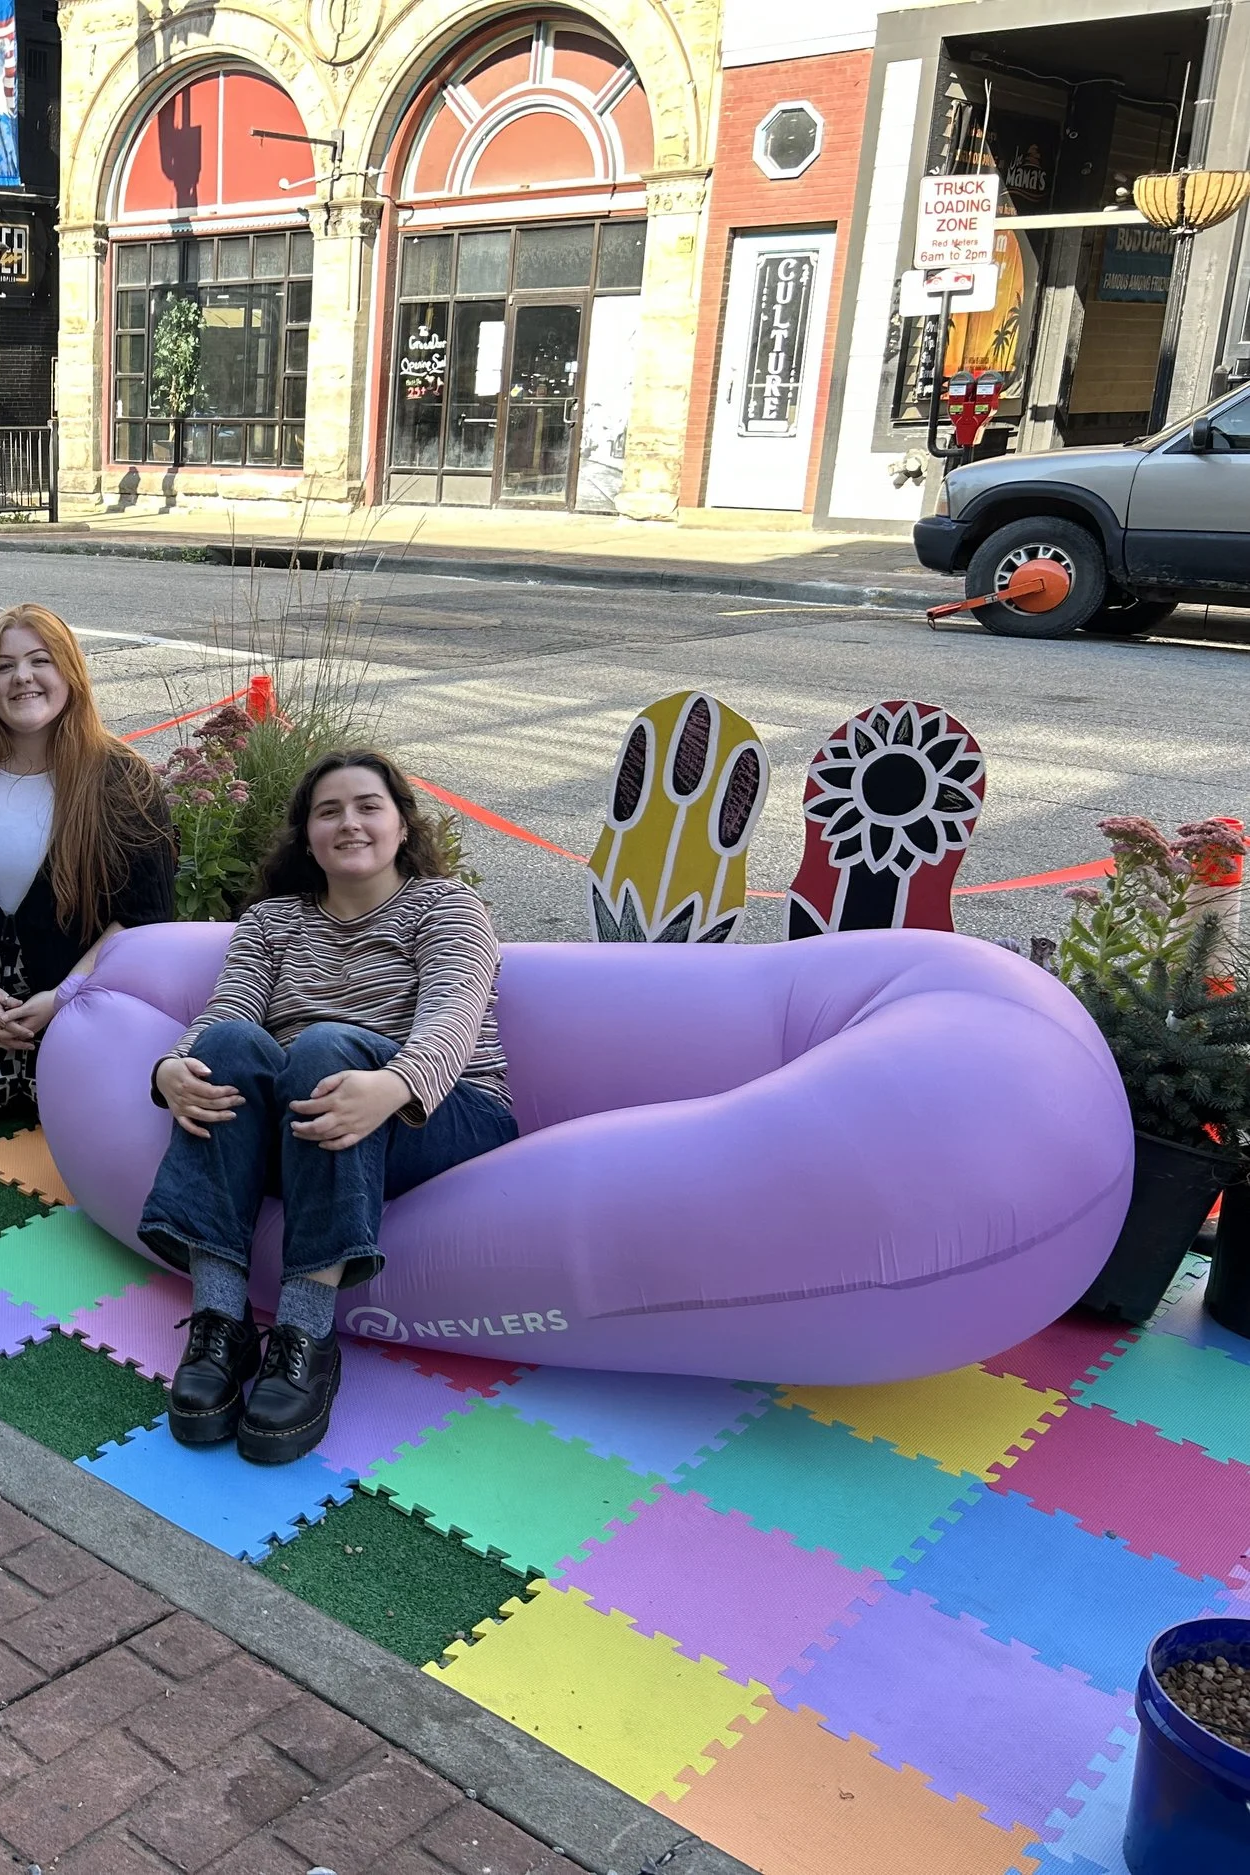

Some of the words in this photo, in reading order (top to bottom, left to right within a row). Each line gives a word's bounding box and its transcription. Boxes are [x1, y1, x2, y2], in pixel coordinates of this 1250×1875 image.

[934, 180, 985, 196] TRUCK
[924, 199, 991, 215] LOADING
[936, 217, 978, 232] ZONE
[932, 239, 948, 248] Red
[952, 238, 979, 247] Meters
[1116, 227, 1141, 252] BUD
[920, 251, 944, 262] 6am
[950, 250, 960, 260] to
[965, 249, 987, 262] 2pm
[1103, 273, 1129, 290] FAMOUS
[762, 258, 798, 419] CULTURE
[412, 1308, 569, 1338] NEVLERS
